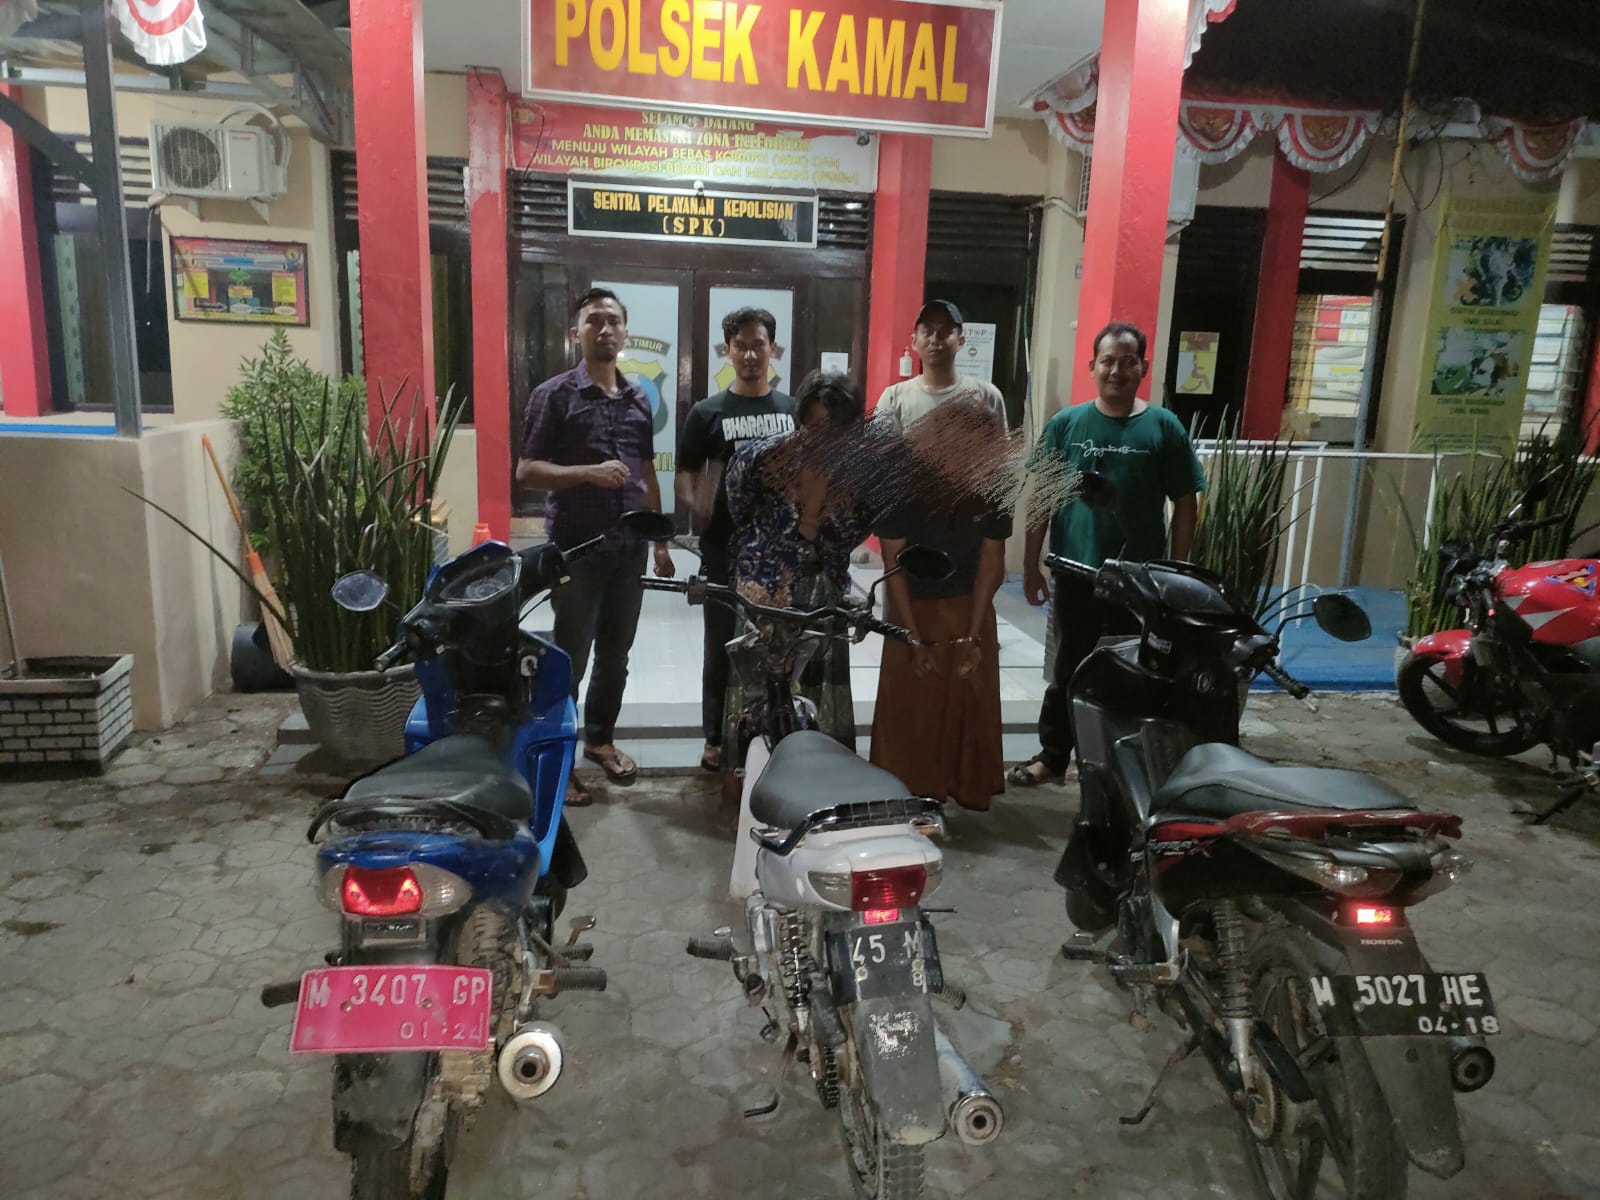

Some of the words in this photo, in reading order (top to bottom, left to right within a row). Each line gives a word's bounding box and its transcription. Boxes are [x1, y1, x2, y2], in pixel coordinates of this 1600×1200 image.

[555, 0, 761, 85] POLSEK
[787, 9, 968, 103] KAMAL
[583, 123, 620, 140] ANDA
[624, 126, 693, 145] MEMASUKI
[696, 132, 730, 147] ZONA
[551, 139, 607, 154] MENUJU
[611, 143, 668, 158] WILAYAH
[672, 148, 711, 160] BEBAS
[531, 152, 589, 168] WILAYAH
[593, 157, 662, 173] BIROKRASI
[593, 191, 641, 212] SENTRA
[647, 194, 715, 216] PELAYANAN
[723, 198, 794, 221] KEPOLISIAN
[633, 338, 663, 351] TIMUR
[1360, 938, 1403, 946] HONDA
[351, 973, 427, 1007] 3407
[452, 974, 486, 1006] GP
[1355, 974, 1428, 1006] 5027
[1441, 974, 1484, 1006] HE
